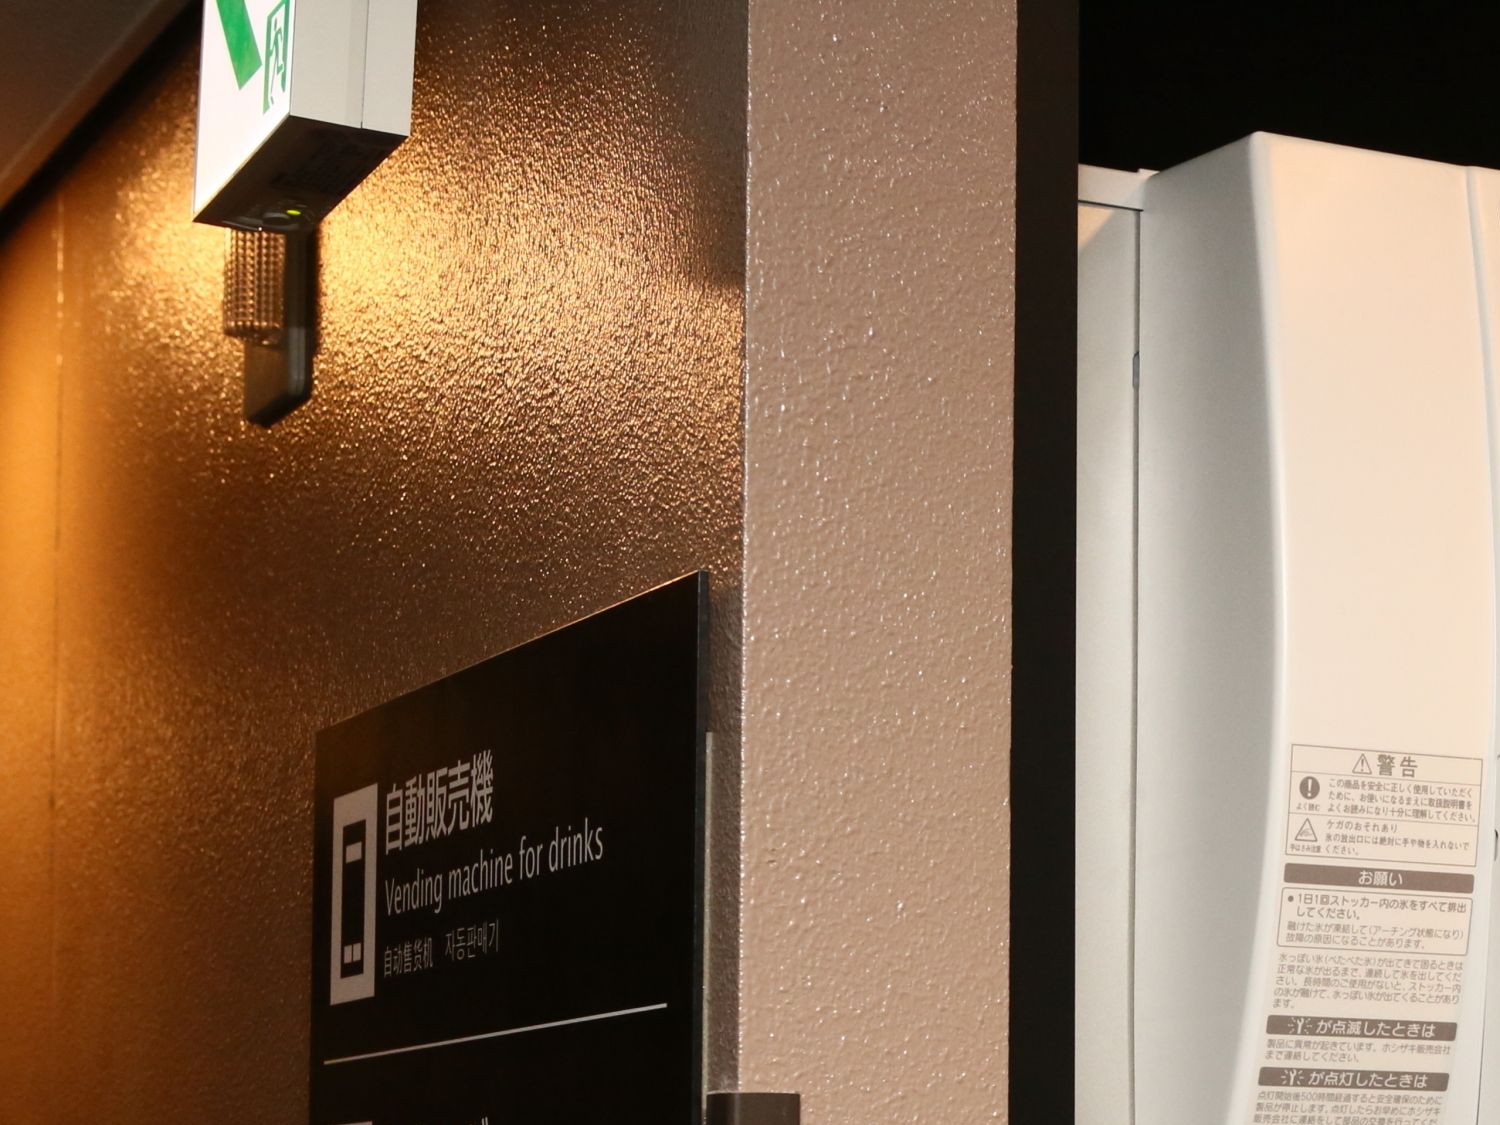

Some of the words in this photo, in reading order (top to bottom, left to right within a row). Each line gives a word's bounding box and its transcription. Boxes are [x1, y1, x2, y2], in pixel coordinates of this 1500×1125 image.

[1377, 754, 1418, 778] 警告
[385, 749, 493, 855] 自動販売機
[385, 868, 443, 917] Vending
[448, 848, 513, 901] machine
[519, 835, 543, 881] for
[548, 817, 603, 873] drinks
[1358, 870, 1403, 886] お願い
[383, 936, 433, 978] 自动售货机
[445, 919, 500, 962] 자동판매기
[1317, 1020, 1436, 1038] が点滅したときは
[1308, 1071, 1428, 1088] が点灯したときは
